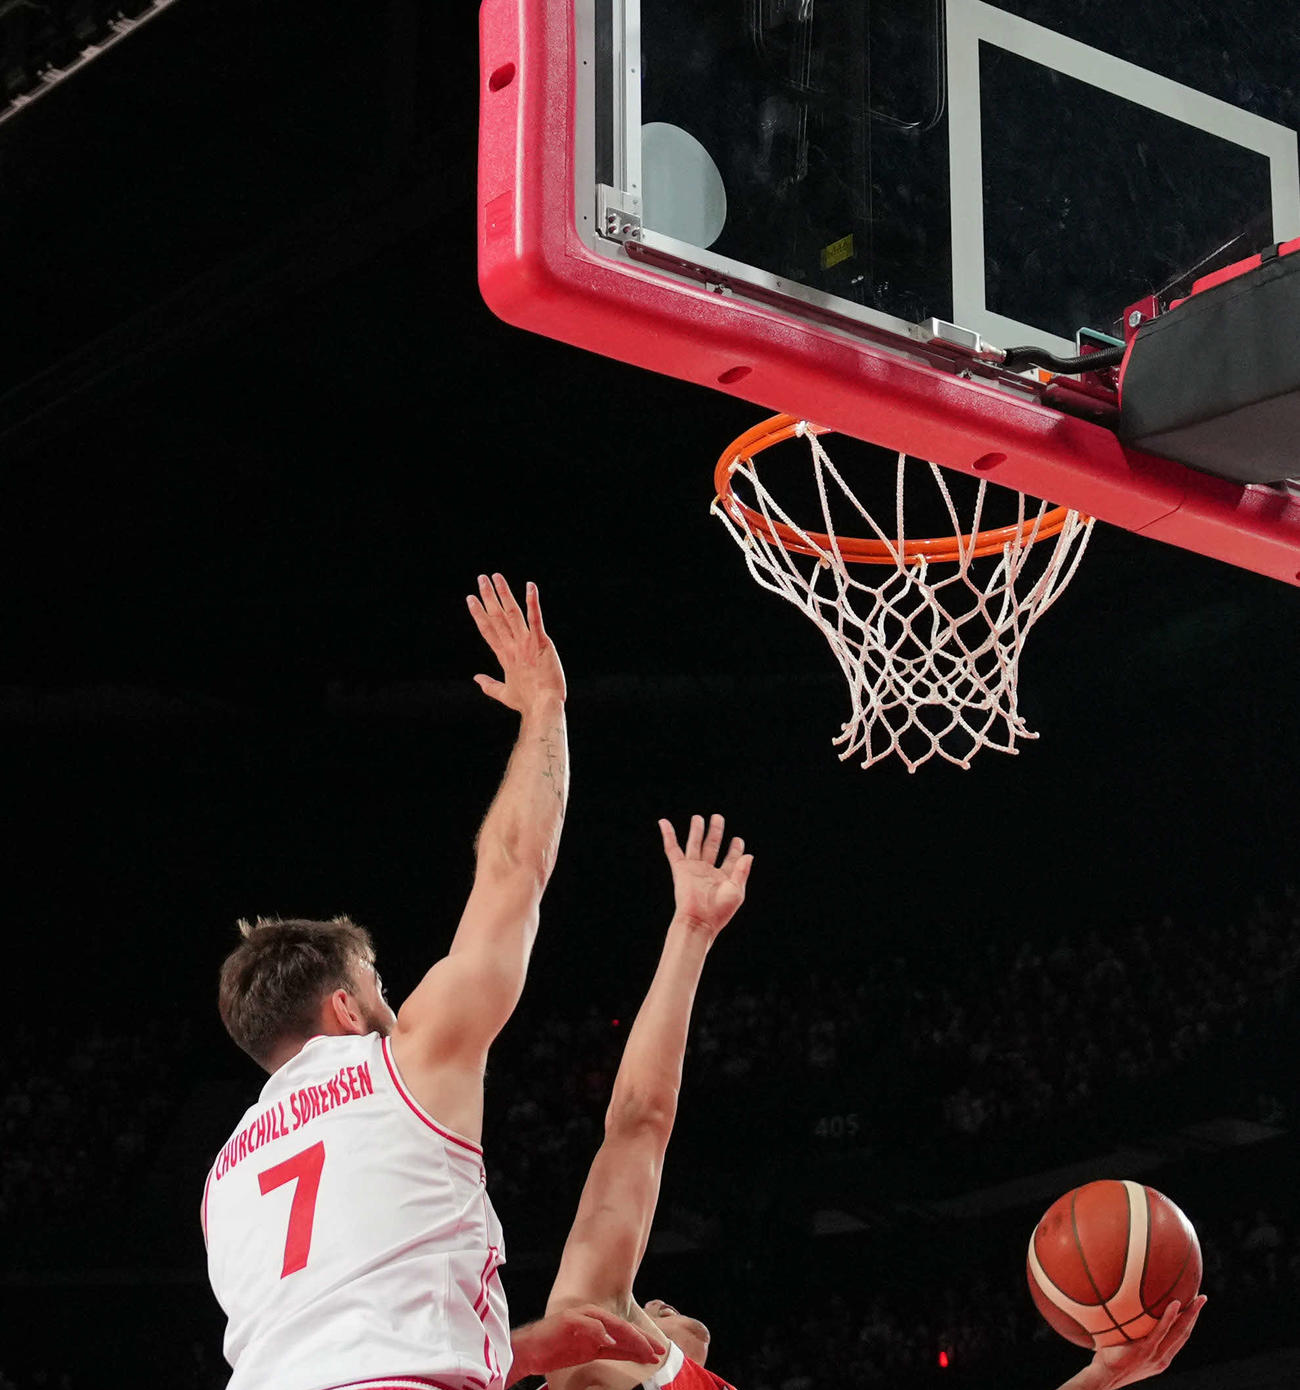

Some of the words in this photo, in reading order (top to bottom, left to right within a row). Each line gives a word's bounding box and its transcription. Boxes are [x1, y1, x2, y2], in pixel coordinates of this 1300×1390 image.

[215, 1102, 289, 1181] CHURCHILL
[289, 1061, 374, 1131] SØRENSEN
[257, 1140, 326, 1280] 7
